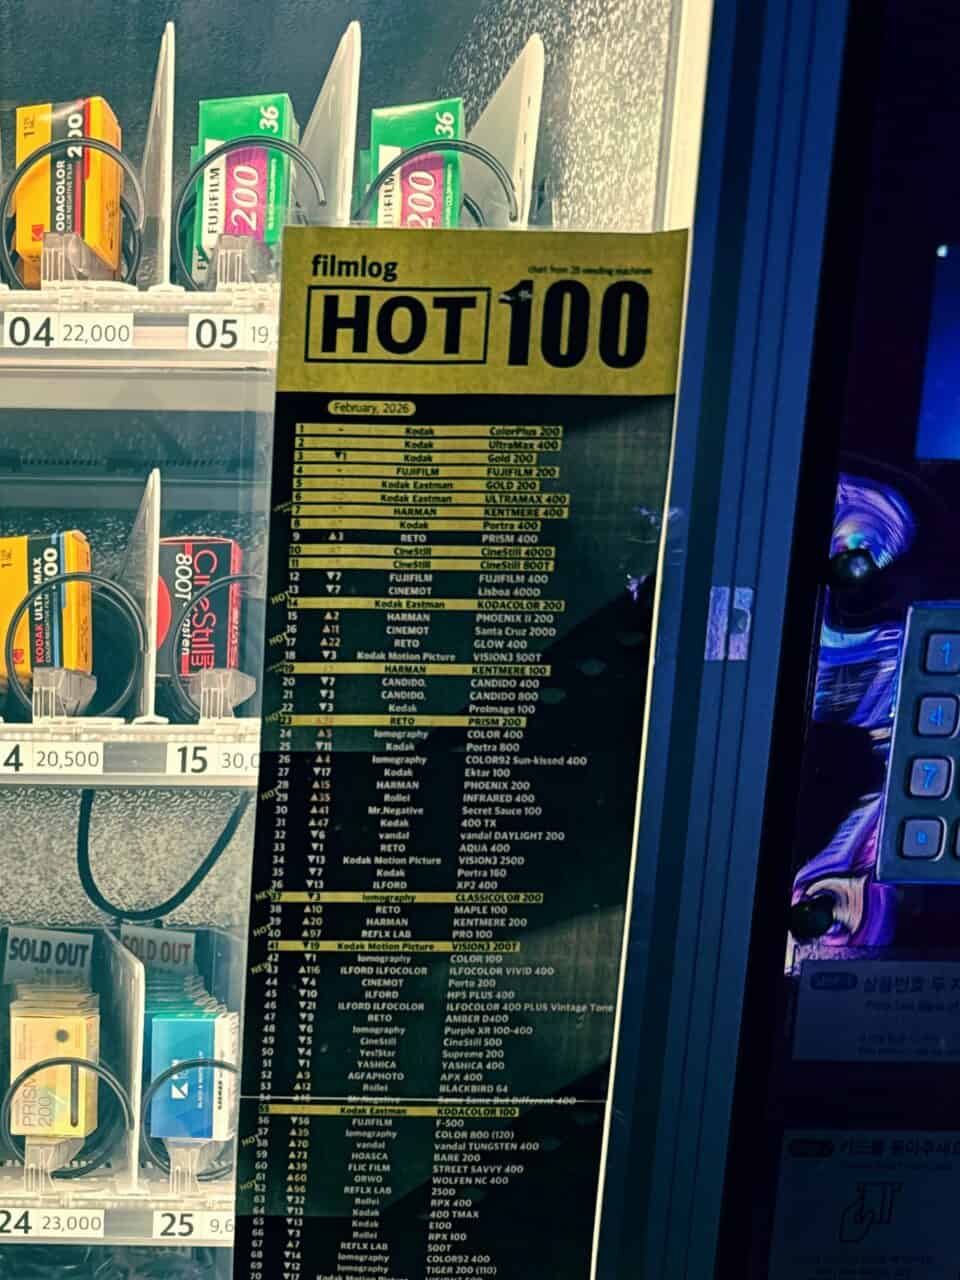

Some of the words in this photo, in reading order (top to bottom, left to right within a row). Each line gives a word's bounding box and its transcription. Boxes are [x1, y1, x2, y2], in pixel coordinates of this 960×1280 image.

[259, 105, 280, 134] 36
[435, 111, 455, 138] 36
[55, 160, 66, 232] ODACOLOR
[207, 167, 221, 235] FUJIFILM
[230, 165, 260, 232] 200
[311, 254, 398, 281] filmlog
[8, 317, 54, 346] 04
[63, 323, 130, 345] 22,000
[195, 318, 238, 349] 05
[321, 294, 478, 355] HOT
[498, 279, 650, 369] 100
[512, 453, 534, 463] 200
[43, 547, 58, 590] 00
[542, 600, 563, 610] 200
[36, 750, 100, 769] 20,500
[178, 746, 209, 774] 15
[221, 752, 259, 772] 30,0
[9, 937, 51, 964] SOLD
[54, 942, 89, 969] OUT
[159, 940, 192, 965] OUT
[41, 1216, 102, 1233] 23,000
[160, 1213, 194, 1237] 25
[209, 1218, 233, 1234] 9,6
